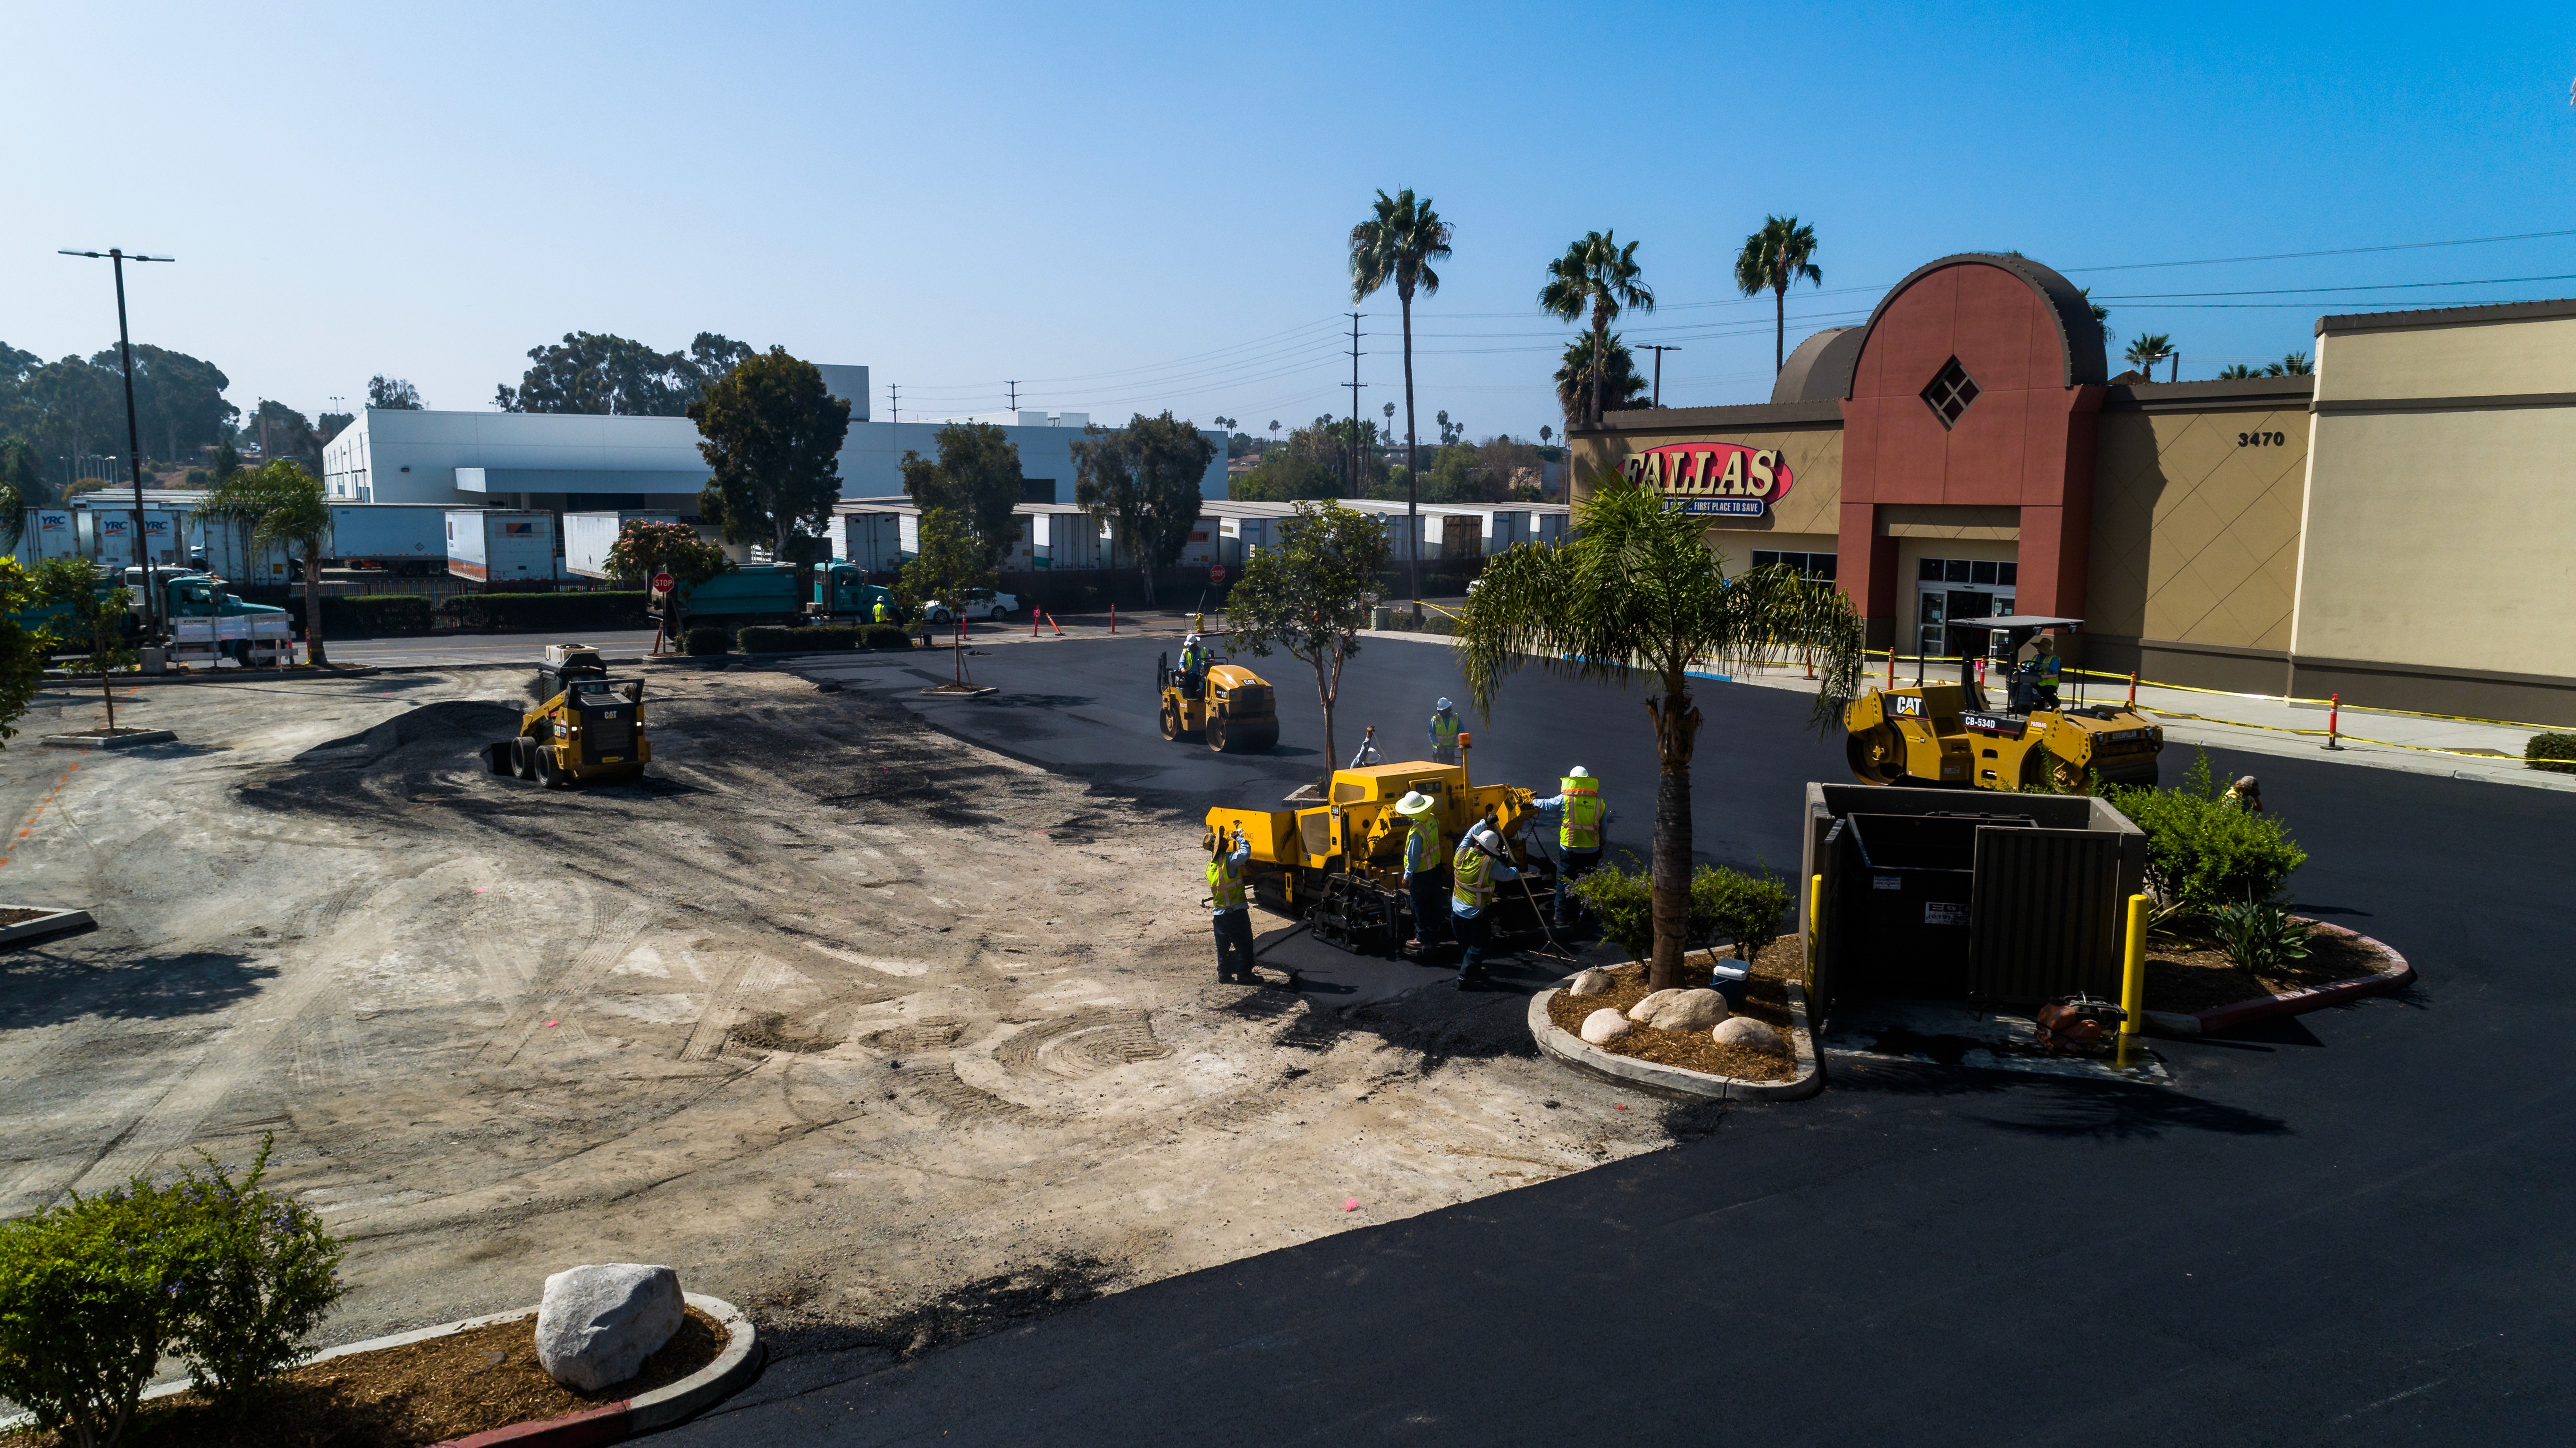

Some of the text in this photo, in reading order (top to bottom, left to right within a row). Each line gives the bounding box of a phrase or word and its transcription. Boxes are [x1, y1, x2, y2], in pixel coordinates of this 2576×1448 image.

[2238, 432, 2285, 447] 3470
[1623, 449, 1777, 496] FALLAS
[1694, 502, 1711, 511] FIRST
[1712, 502, 1731, 511] PLACE
[1733, 503, 1740, 512] TO
[1742, 503, 1758, 512] SAVE
[42, 516, 66, 524] YRC
[104, 521, 128, 529] YRC
[145, 521, 168, 529] YRC
[1897, 696, 1921, 716] CAT
[605, 711, 617, 719] CAT
[1965, 716, 1995, 728] CB-534D
[2112, 730, 2137, 739] CATERPILLAR
